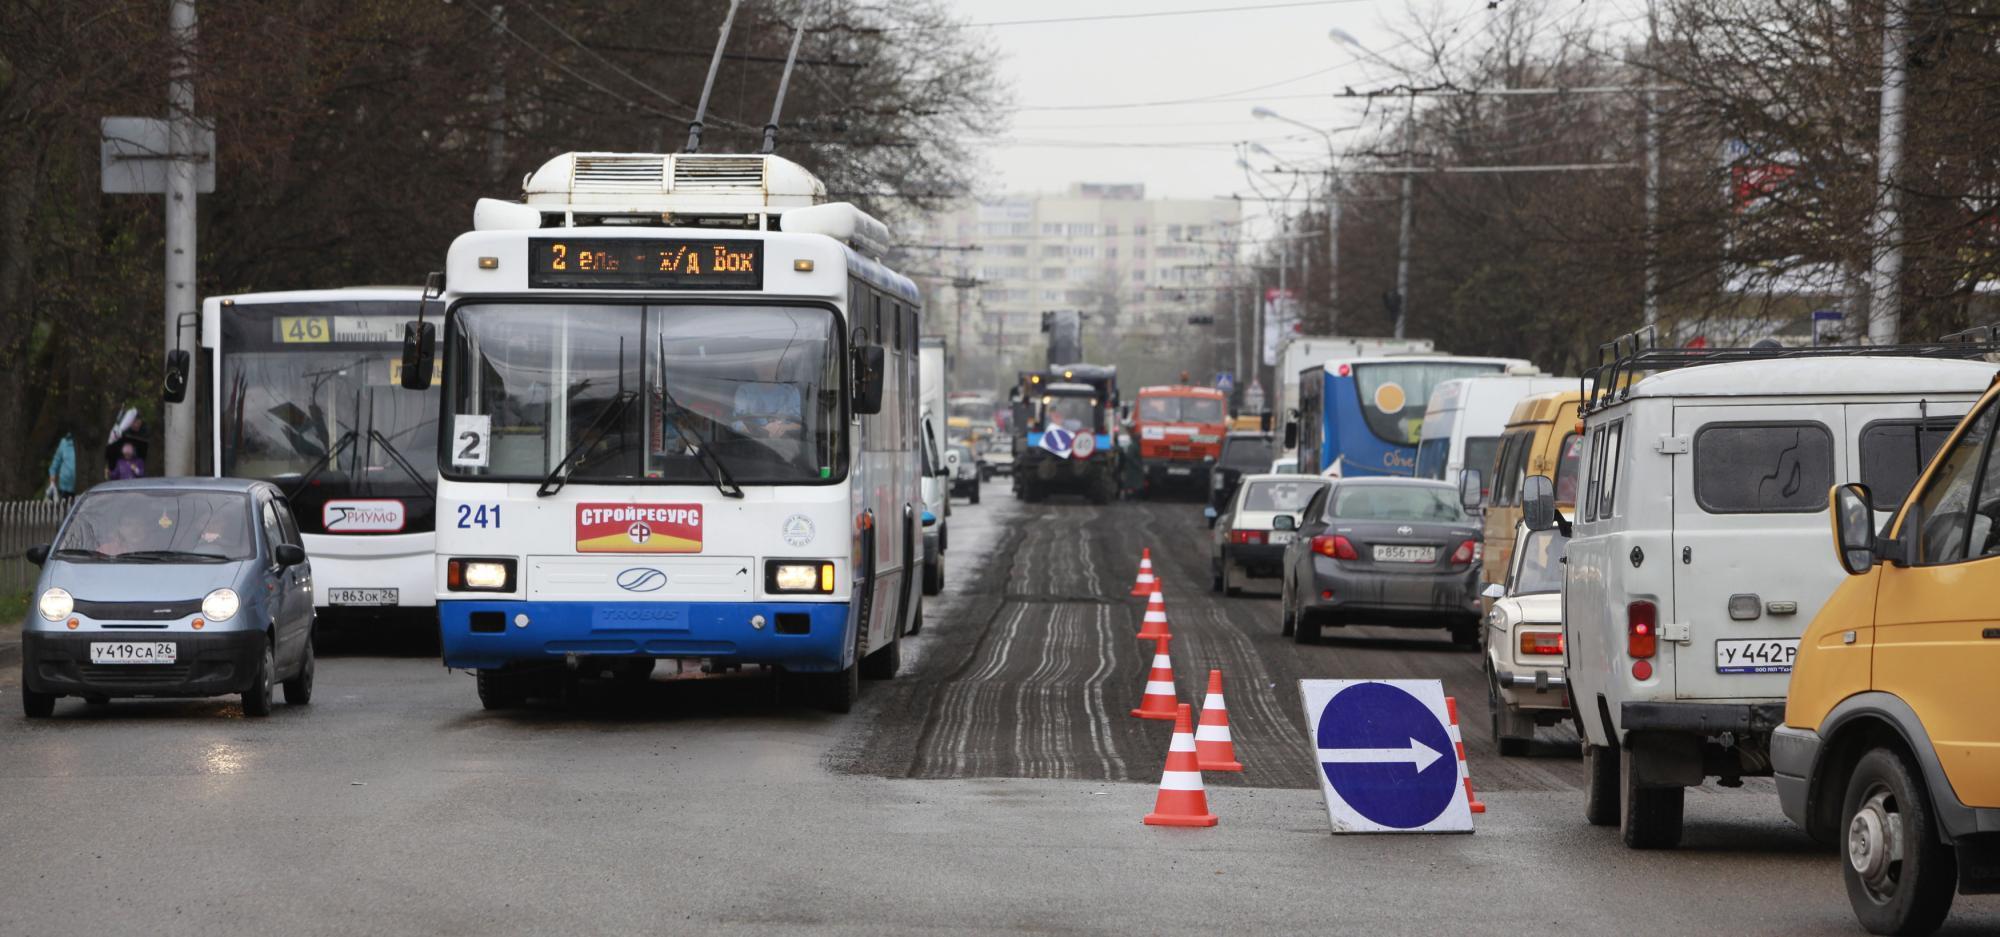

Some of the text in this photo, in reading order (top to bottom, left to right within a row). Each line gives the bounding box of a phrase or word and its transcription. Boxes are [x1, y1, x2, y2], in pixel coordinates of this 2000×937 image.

[552, 244, 566, 270] 2
[713, 245, 753, 272] Вок
[289, 318, 322, 341] 46
[458, 431, 481, 460] 2
[457, 504, 501, 529] 241
[581, 506, 699, 527] СТРОЙРЕСУРС
